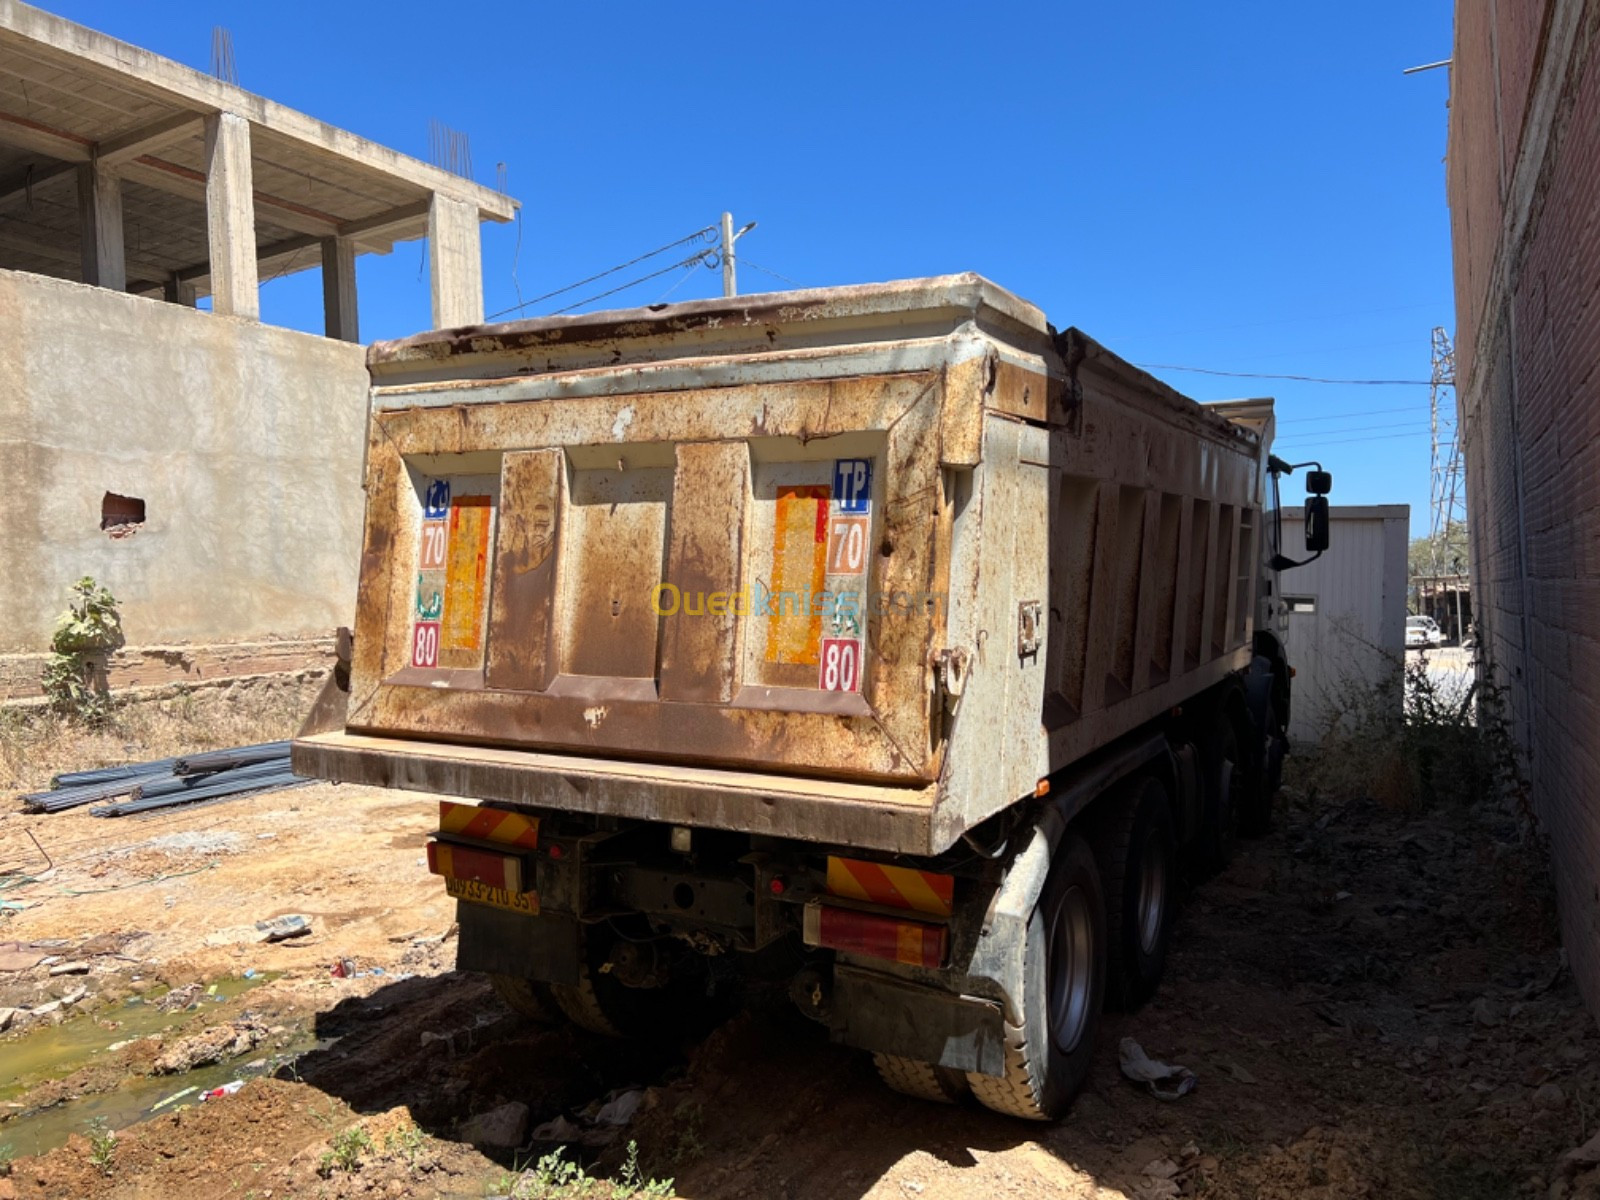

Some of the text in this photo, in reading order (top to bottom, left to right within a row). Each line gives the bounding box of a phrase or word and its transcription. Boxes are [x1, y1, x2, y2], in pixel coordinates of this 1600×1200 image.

[838, 461, 867, 509] TP
[424, 526, 445, 565] 70
[834, 523, 863, 569] 70
[415, 626, 436, 666] 80
[825, 644, 854, 691] 80
